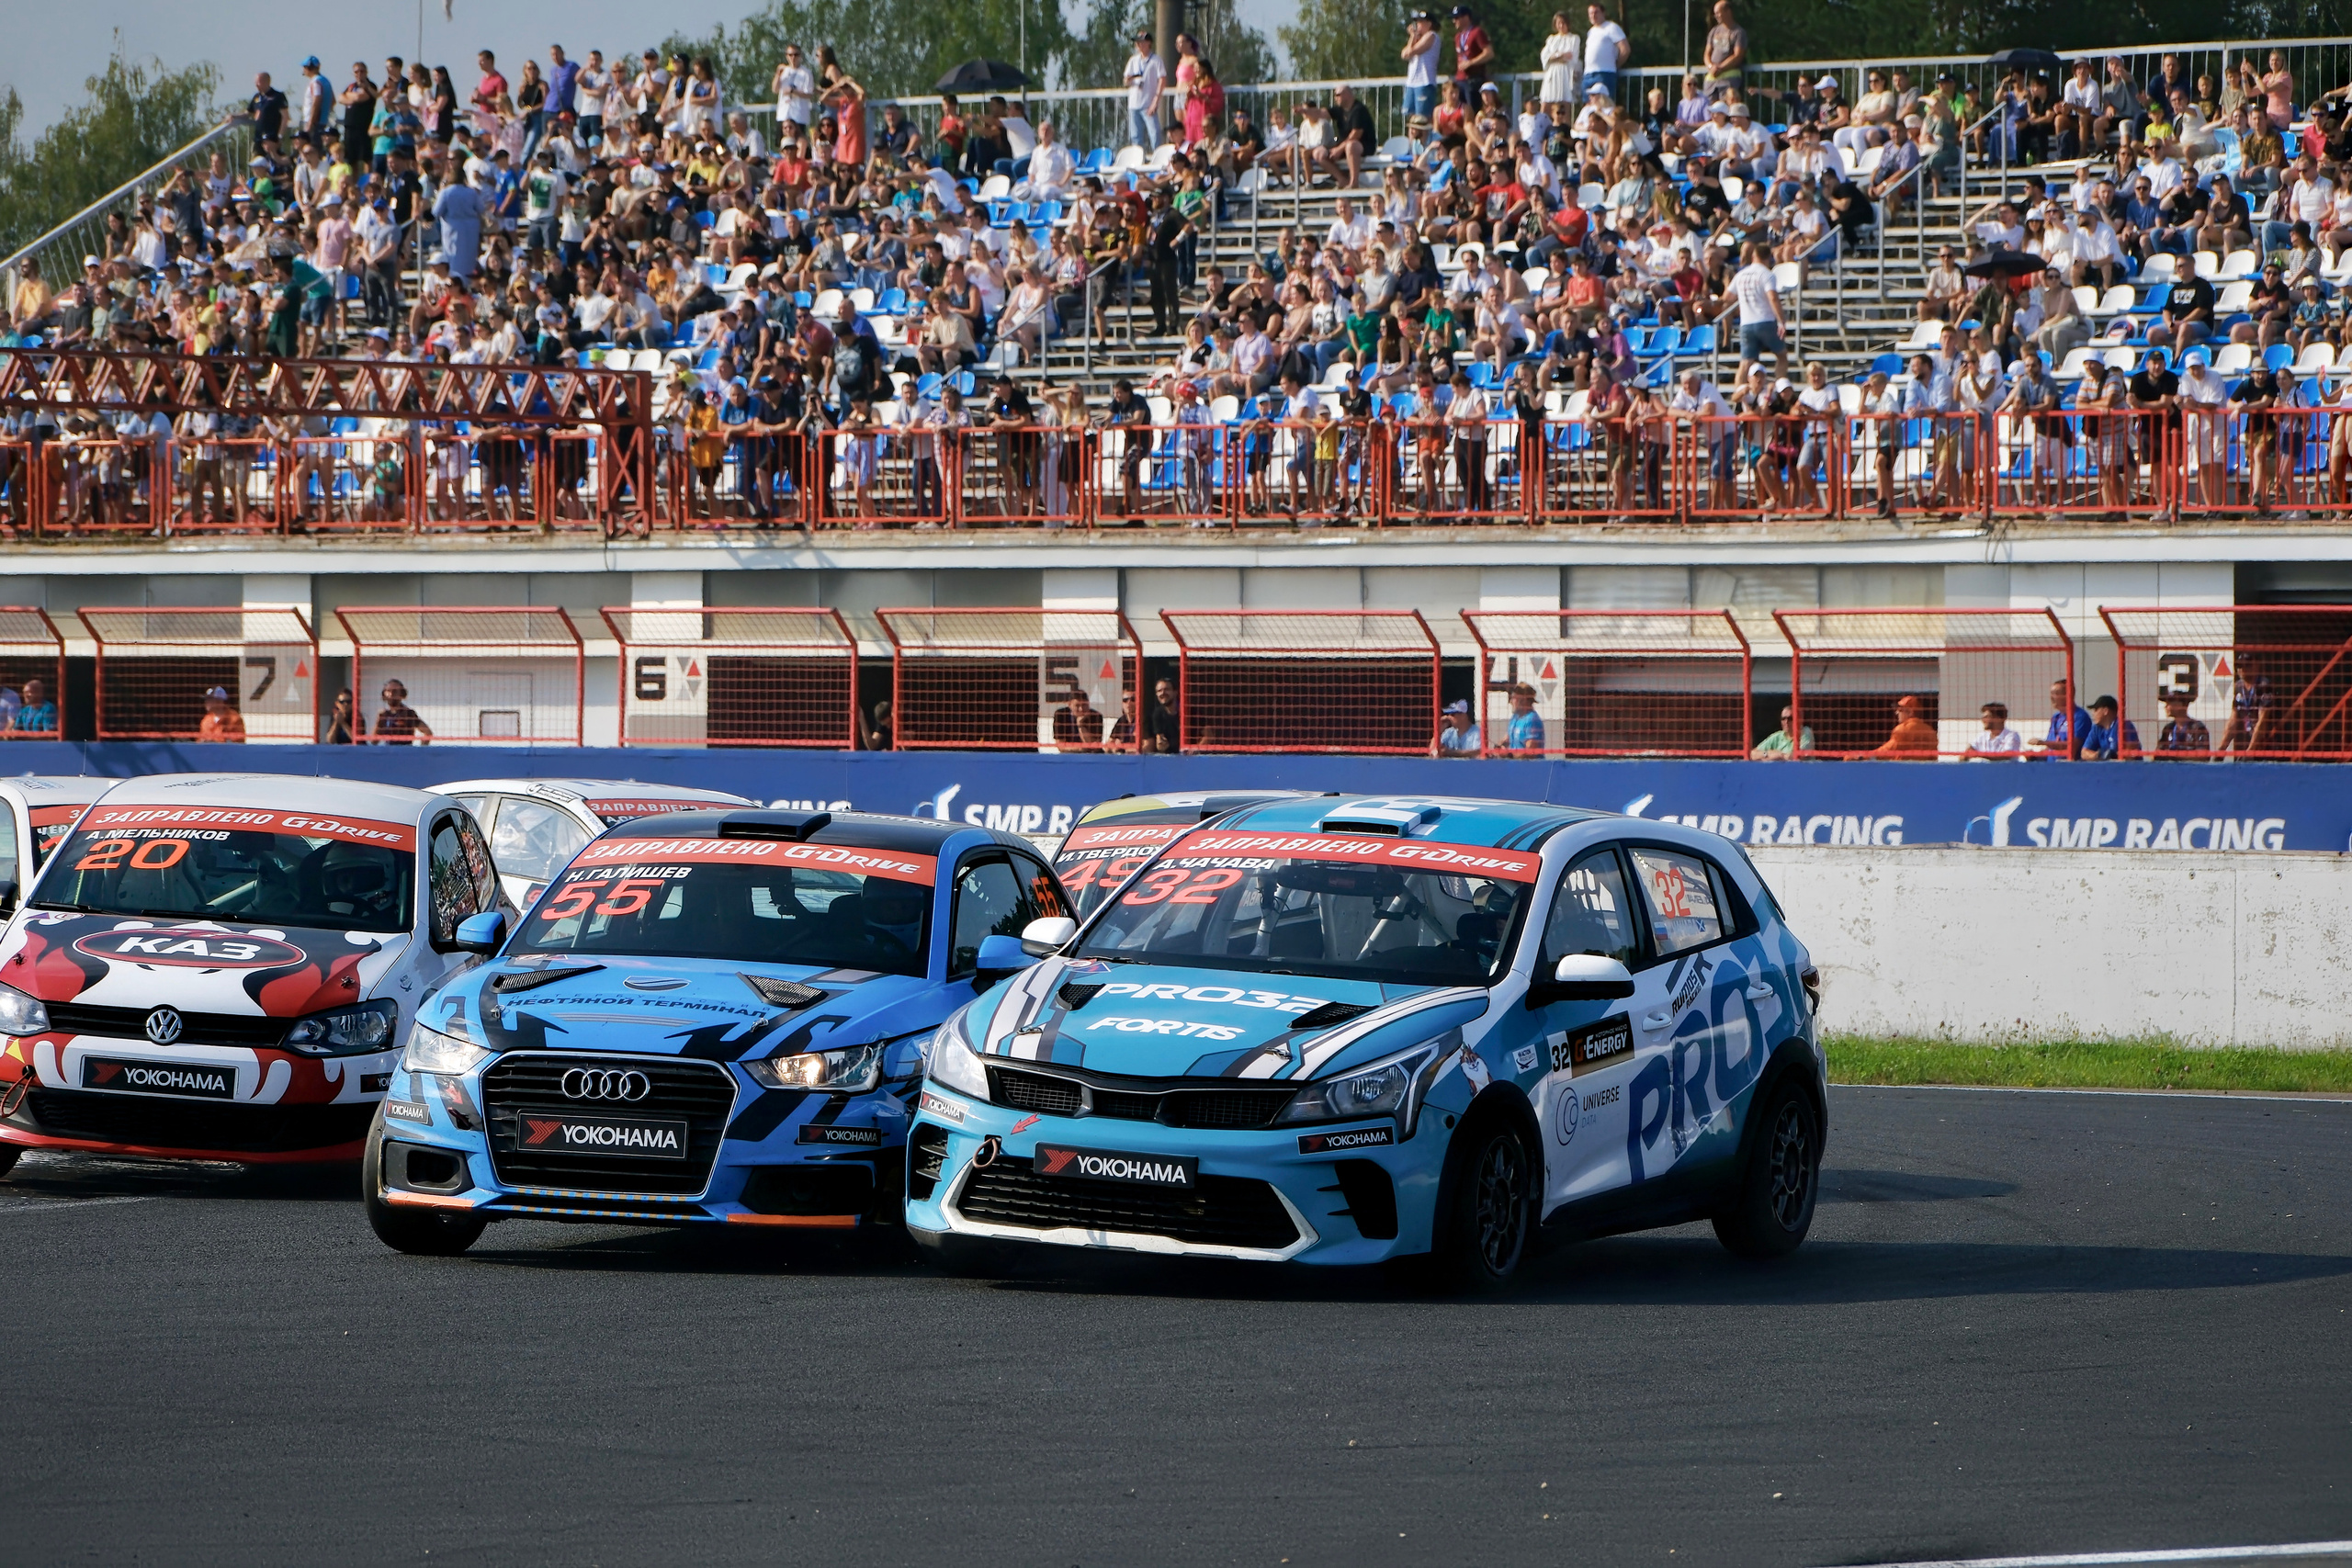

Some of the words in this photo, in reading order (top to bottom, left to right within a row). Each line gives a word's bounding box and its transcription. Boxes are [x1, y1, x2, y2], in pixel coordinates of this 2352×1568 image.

[245, 656, 276, 701] 7
[635, 656, 666, 701] 6
[1046, 656, 1079, 703] 5
[2159, 653, 2199, 703] 3
[95, 809, 275, 825] ЗАПРАВЛЕНО
[964, 804, 1043, 832] SMP
[85, 829, 231, 841] А.МЕЛЬНИКОВ
[1749, 814, 1904, 846] RACING
[2026, 817, 2118, 848] SMP
[2124, 817, 2286, 851] RACING
[74, 839, 190, 871] 20
[583, 840, 778, 860] ЗАПРАВЛЕНО
[1188, 837, 1385, 855] ЗАПРАВЛЕНО
[564, 866, 693, 883] Н.ГАЛИШЕВ
[1152, 857, 1276, 871] А.ЧАЧАВА
[541, 879, 666, 920] 55
[1031, 876, 1060, 918] 55
[1122, 867, 1243, 907] 32
[1655, 867, 1691, 919] 32
[115, 936, 262, 961] КАЗ
[506, 996, 634, 1008] НЕФТЯНОЙ
[642, 999, 767, 1019] ТЕРМИНАЛ
[1093, 983, 1335, 1015] PRO32
[1085, 1017, 1247, 1041] FORTIS
[1551, 1042, 1570, 1073] 32
[124, 1067, 226, 1091] YOKOHAMA
[927, 1096, 961, 1119] YOKOHAMA
[1583, 1085, 1620, 1111] UNIVERSE
[390, 1104, 424, 1119] YOKOHAMA
[1581, 1114, 1597, 1128] DATA
[562, 1124, 678, 1149] YOKOHAMA
[824, 1129, 877, 1143] YOKOHAMA
[1326, 1131, 1388, 1147] YOKOHAMA
[1077, 1155, 1187, 1184] YOKOHAMA
